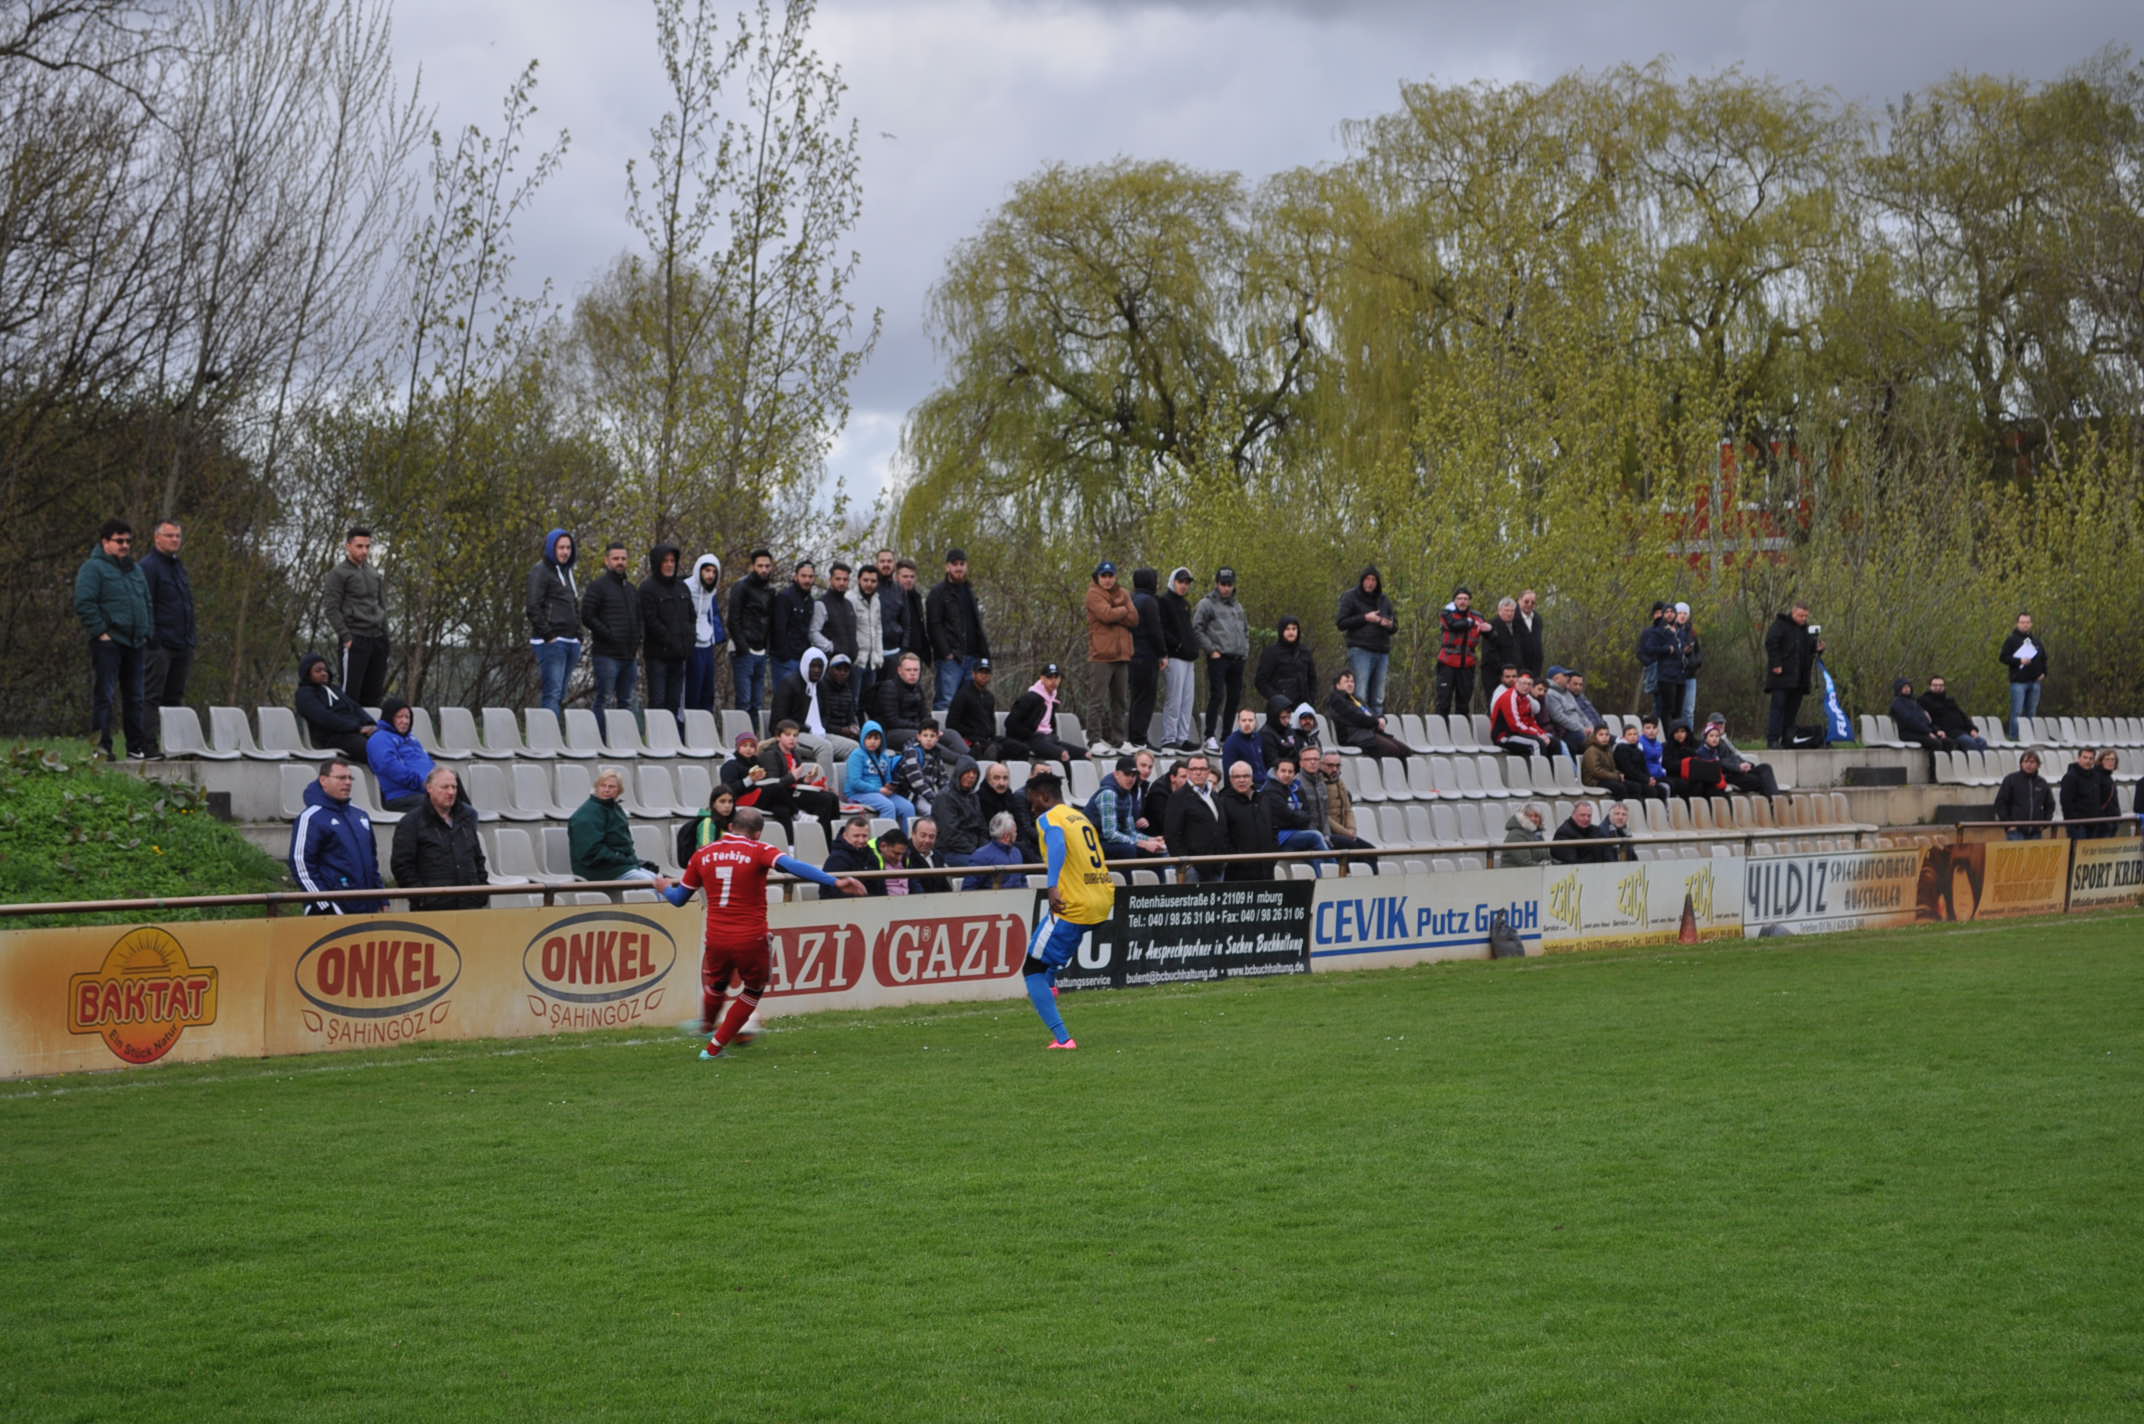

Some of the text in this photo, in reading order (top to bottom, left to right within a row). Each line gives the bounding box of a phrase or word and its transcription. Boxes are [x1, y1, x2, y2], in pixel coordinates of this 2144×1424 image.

[1082, 826, 1102, 869] 9
[715, 866, 733, 907] 7
[1748, 859, 1828, 918] YILDIZ
[2074, 860, 2144, 891] SPORT KRIB
[1128, 914, 1146, 928] Tel.:
[1148, 913, 1163, 927] 040
[1170, 912, 1180, 926] 98
[1181, 912, 1192, 925] 26
[1193, 911, 1203, 925] 31
[1205, 911, 1215, 924] 04
[1240, 909, 1255, 922] 040
[1261, 908, 1271, 922] 98
[1272, 908, 1282, 921] 26
[1283, 907, 1293, 920] 31
[1294, 907, 1304, 920] 06
[1129, 890, 1283, 909] Rotenhäuserstraße 8 21109 Hmburg
[1316, 896, 1409, 945] CEVIK
[1417, 907, 1469, 937] Putz
[317, 940, 441, 999] ONKEL
[541, 931, 656, 985] ONKEL
[1126, 933, 1304, 965] Ihr Ansprechpartner in Sachen Buchhaltung
[1227, 962, 1304, 977] www.bcbuchhaltung.de
[78, 978, 210, 1024] BAKTAT
[154, 1023, 178, 1049] Natur
